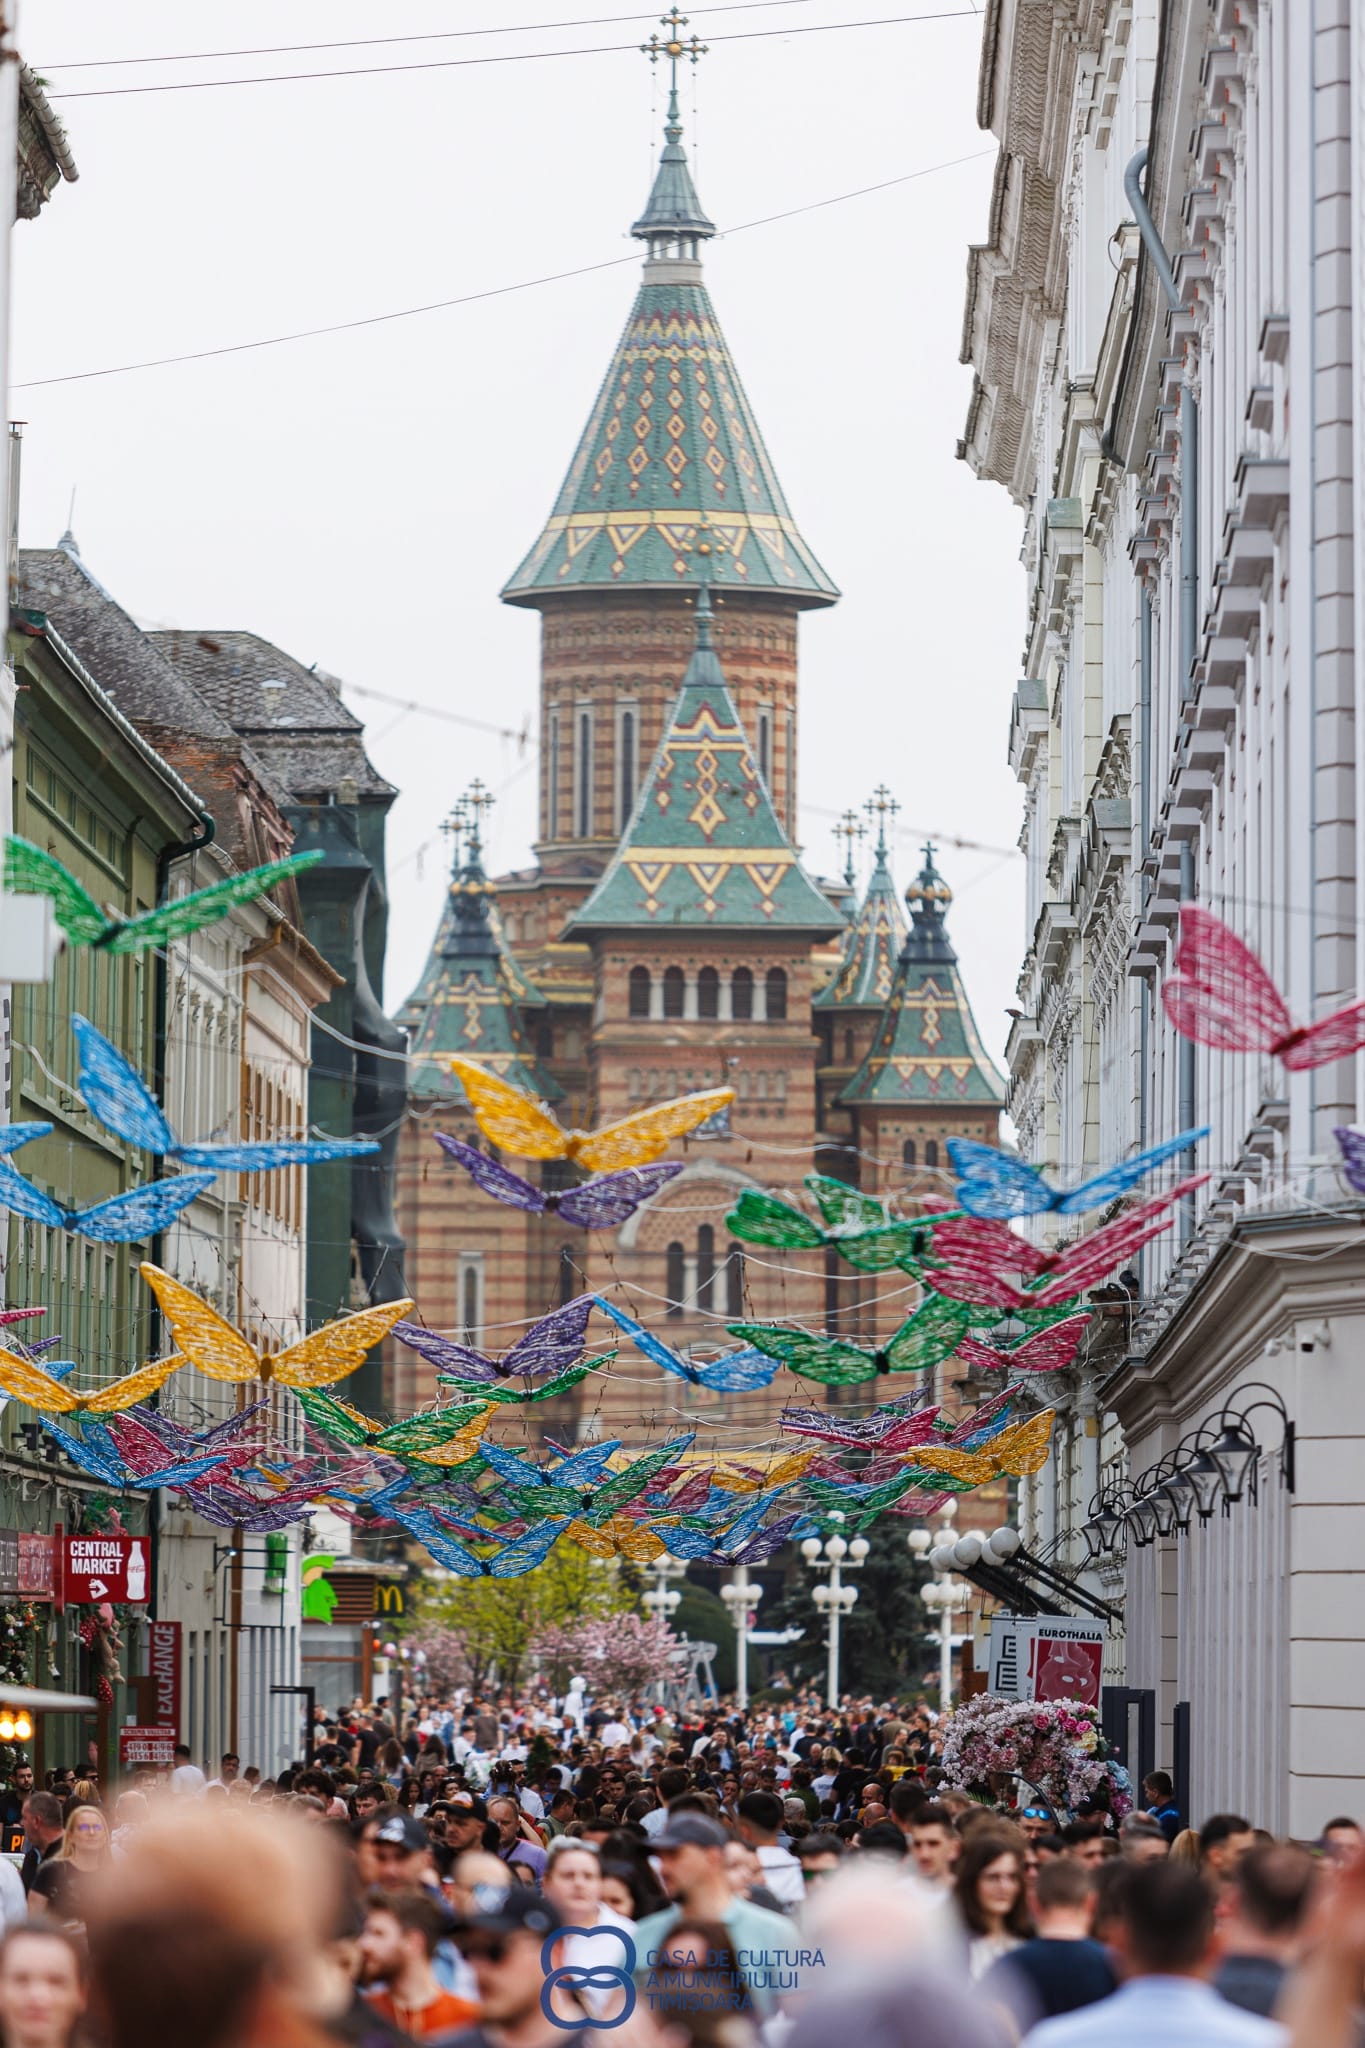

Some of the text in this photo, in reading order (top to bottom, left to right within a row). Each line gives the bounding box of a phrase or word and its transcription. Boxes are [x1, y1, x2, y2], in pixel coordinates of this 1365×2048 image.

[70, 1541, 123, 1557] CENTRAL
[72, 1559, 122, 1574] MARKET
[1038, 1628, 1103, 1641] EUROTHALIA
[154, 1624, 174, 1715] EXCHANGE
